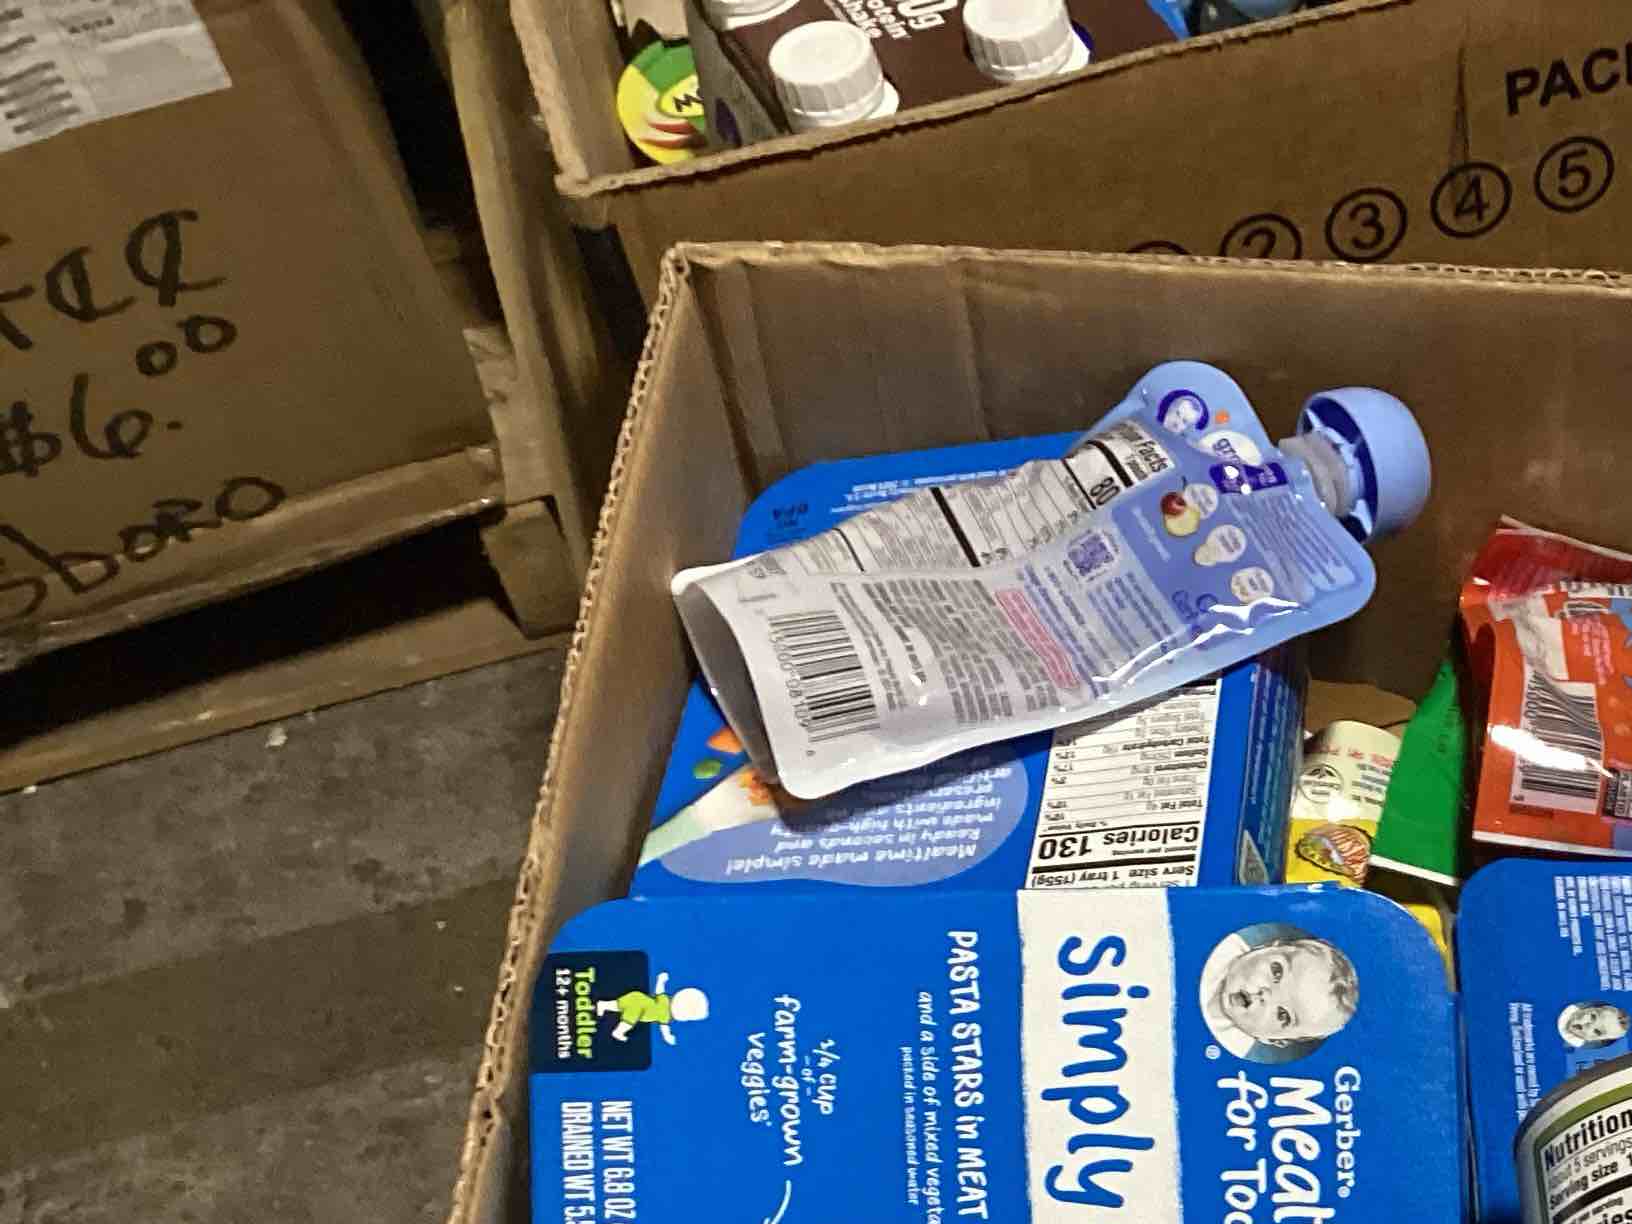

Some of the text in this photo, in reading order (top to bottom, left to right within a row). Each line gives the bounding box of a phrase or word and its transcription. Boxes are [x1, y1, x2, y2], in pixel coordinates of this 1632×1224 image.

[1090, 477, 1120, 505] 80
[1038, 827, 1200, 861] Calories 130
[1128, 866, 1156, 881] size
[1159, 863, 1195, 878] Serv
[946, 930, 981, 1014] PASTA
[575, 967, 596, 1058] Toddler
[918, 992, 934, 1025] and
[556, 999, 573, 1059] months
[772, 994, 803, 1166] farm-grown
[920, 1047, 940, 1081] side
[951, 1022, 984, 1107] STARS
[1040, 934, 1156, 1209] simply
[812, 1073, 837, 1115] cup
[1216, 1070, 1269, 1152] for
[601, 1100, 633, 1131] NET
[954, 1116, 986, 1141] in
[1334, 1066, 1361, 1186] Gerber
[561, 1101, 594, 1171] DRAINED
[602, 1136, 634, 1163] WT
[922, 1113, 940, 1164] mixed
[563, 1174, 595, 1201] WT
[603, 1168, 634, 1194] 6.8
[954, 1147, 988, 1220] MEAT
[604, 1198, 636, 1219] OZ
